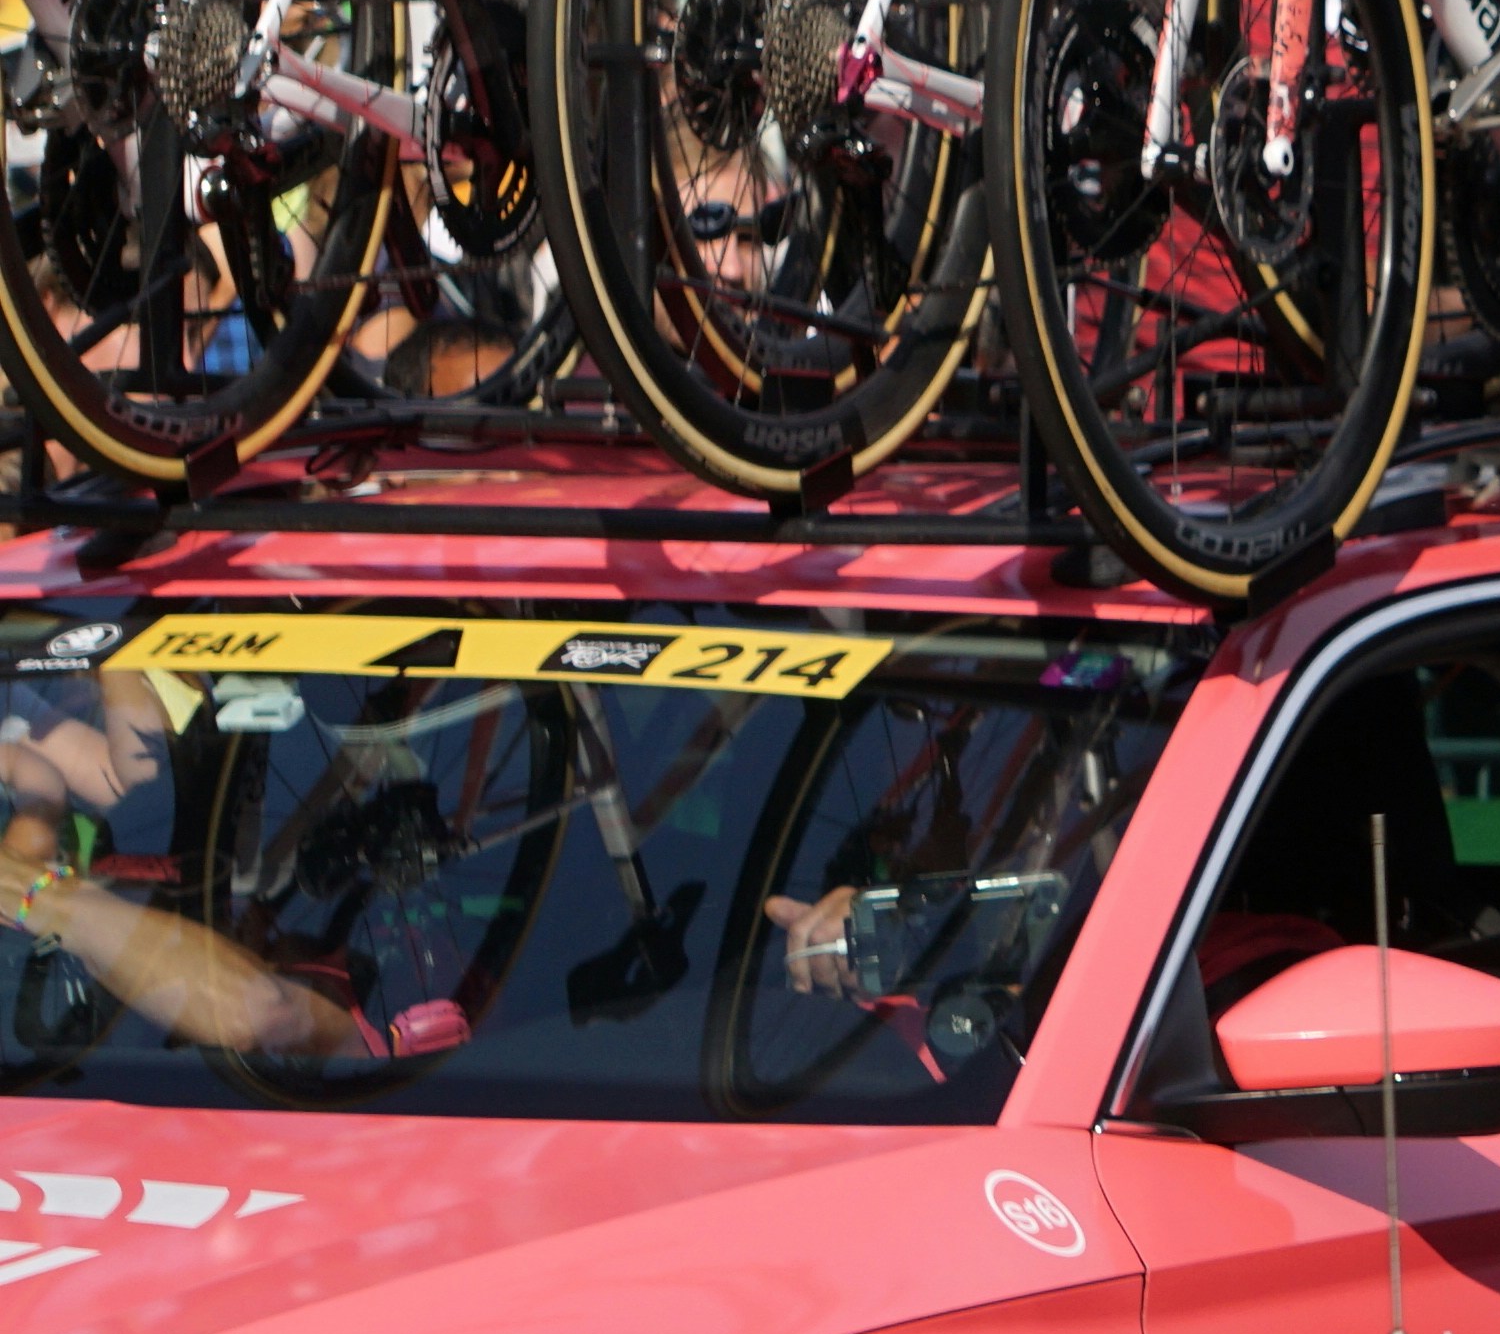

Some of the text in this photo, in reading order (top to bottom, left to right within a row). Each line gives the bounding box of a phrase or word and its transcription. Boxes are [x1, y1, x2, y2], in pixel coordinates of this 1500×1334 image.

[148, 631, 282, 657] TEAM
[670, 643, 849, 688] 214
[1004, 1195, 1068, 1235] S16
